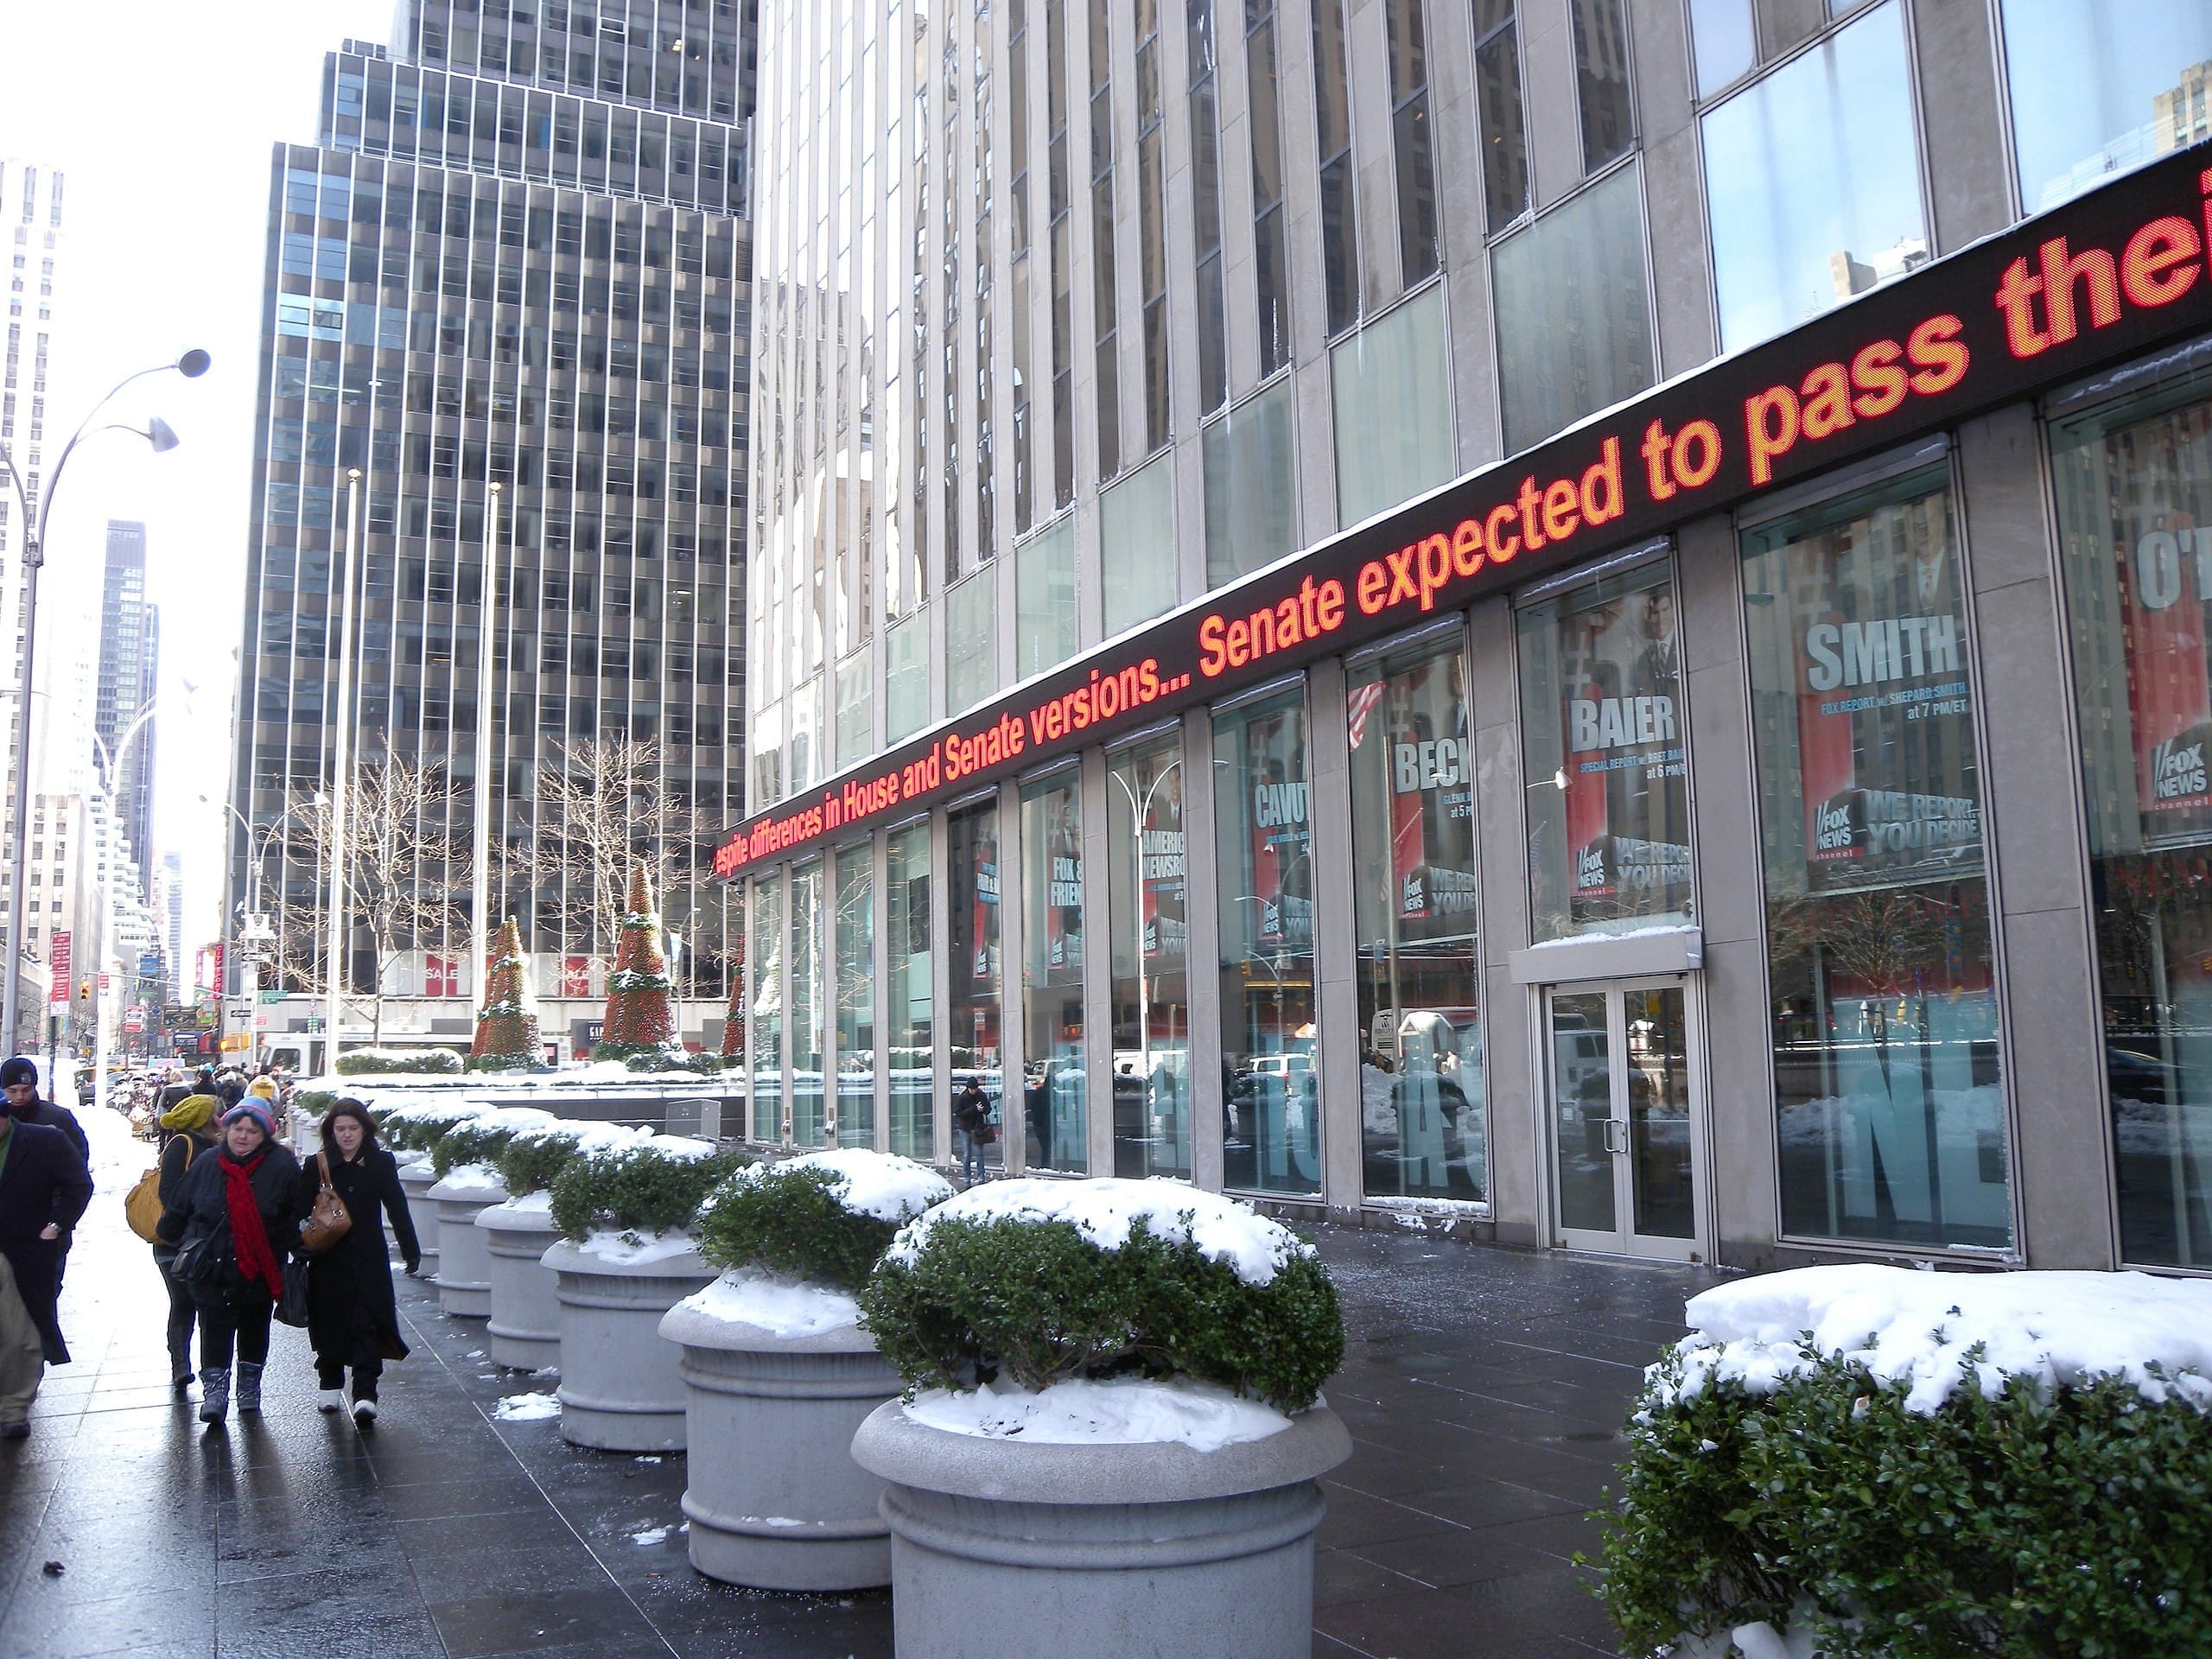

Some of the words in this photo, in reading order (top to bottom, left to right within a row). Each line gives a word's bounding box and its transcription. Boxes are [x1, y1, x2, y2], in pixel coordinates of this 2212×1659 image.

[749, 804, 823, 860] differences
[825, 791, 842, 830] in
[843, 772, 900, 823] House
[903, 742, 940, 799] and
[945, 711, 1025, 782] Senate
[1029, 658, 1191, 747] versions...
[1198, 575, 1345, 678] Senate
[1357, 435, 1624, 613] expected
[1641, 417, 1723, 501] to
[1744, 314, 1970, 486] pass
[1807, 614, 1960, 691] SMITH
[1821, 702, 1839, 715] FOX
[1840, 696, 1874, 712] REPORT
[1934, 682, 1966, 697] SMITH
[1908, 707, 1920, 720] at
[1923, 703, 1930, 717] 7
[1933, 699, 1967, 715] PM/ET
[1570, 696, 1675, 753] BAIER
[1647, 767, 1656, 779] at
[1657, 765, 1664, 778] 6
[2164, 743, 2205, 777] FOX
[2157, 769, 2207, 798] NEWS
[1865, 789, 1907, 821] WE
[2154, 796, 2209, 810] channel
[1823, 804, 1851, 833] FOX
[1614, 836, 1649, 864] WE
[1818, 826, 1853, 850] NEWS
[1867, 821, 1923, 855] YOU
[1053, 857, 1074, 880] FOX
[1583, 850, 1604, 873] FOX
[1407, 878, 1423, 898] FOX
[1579, 868, 1605, 888] NEWS
[1617, 865, 1656, 893] YOU
[1404, 895, 1424, 912] NEWS
[1432, 892, 1461, 916] YOU
